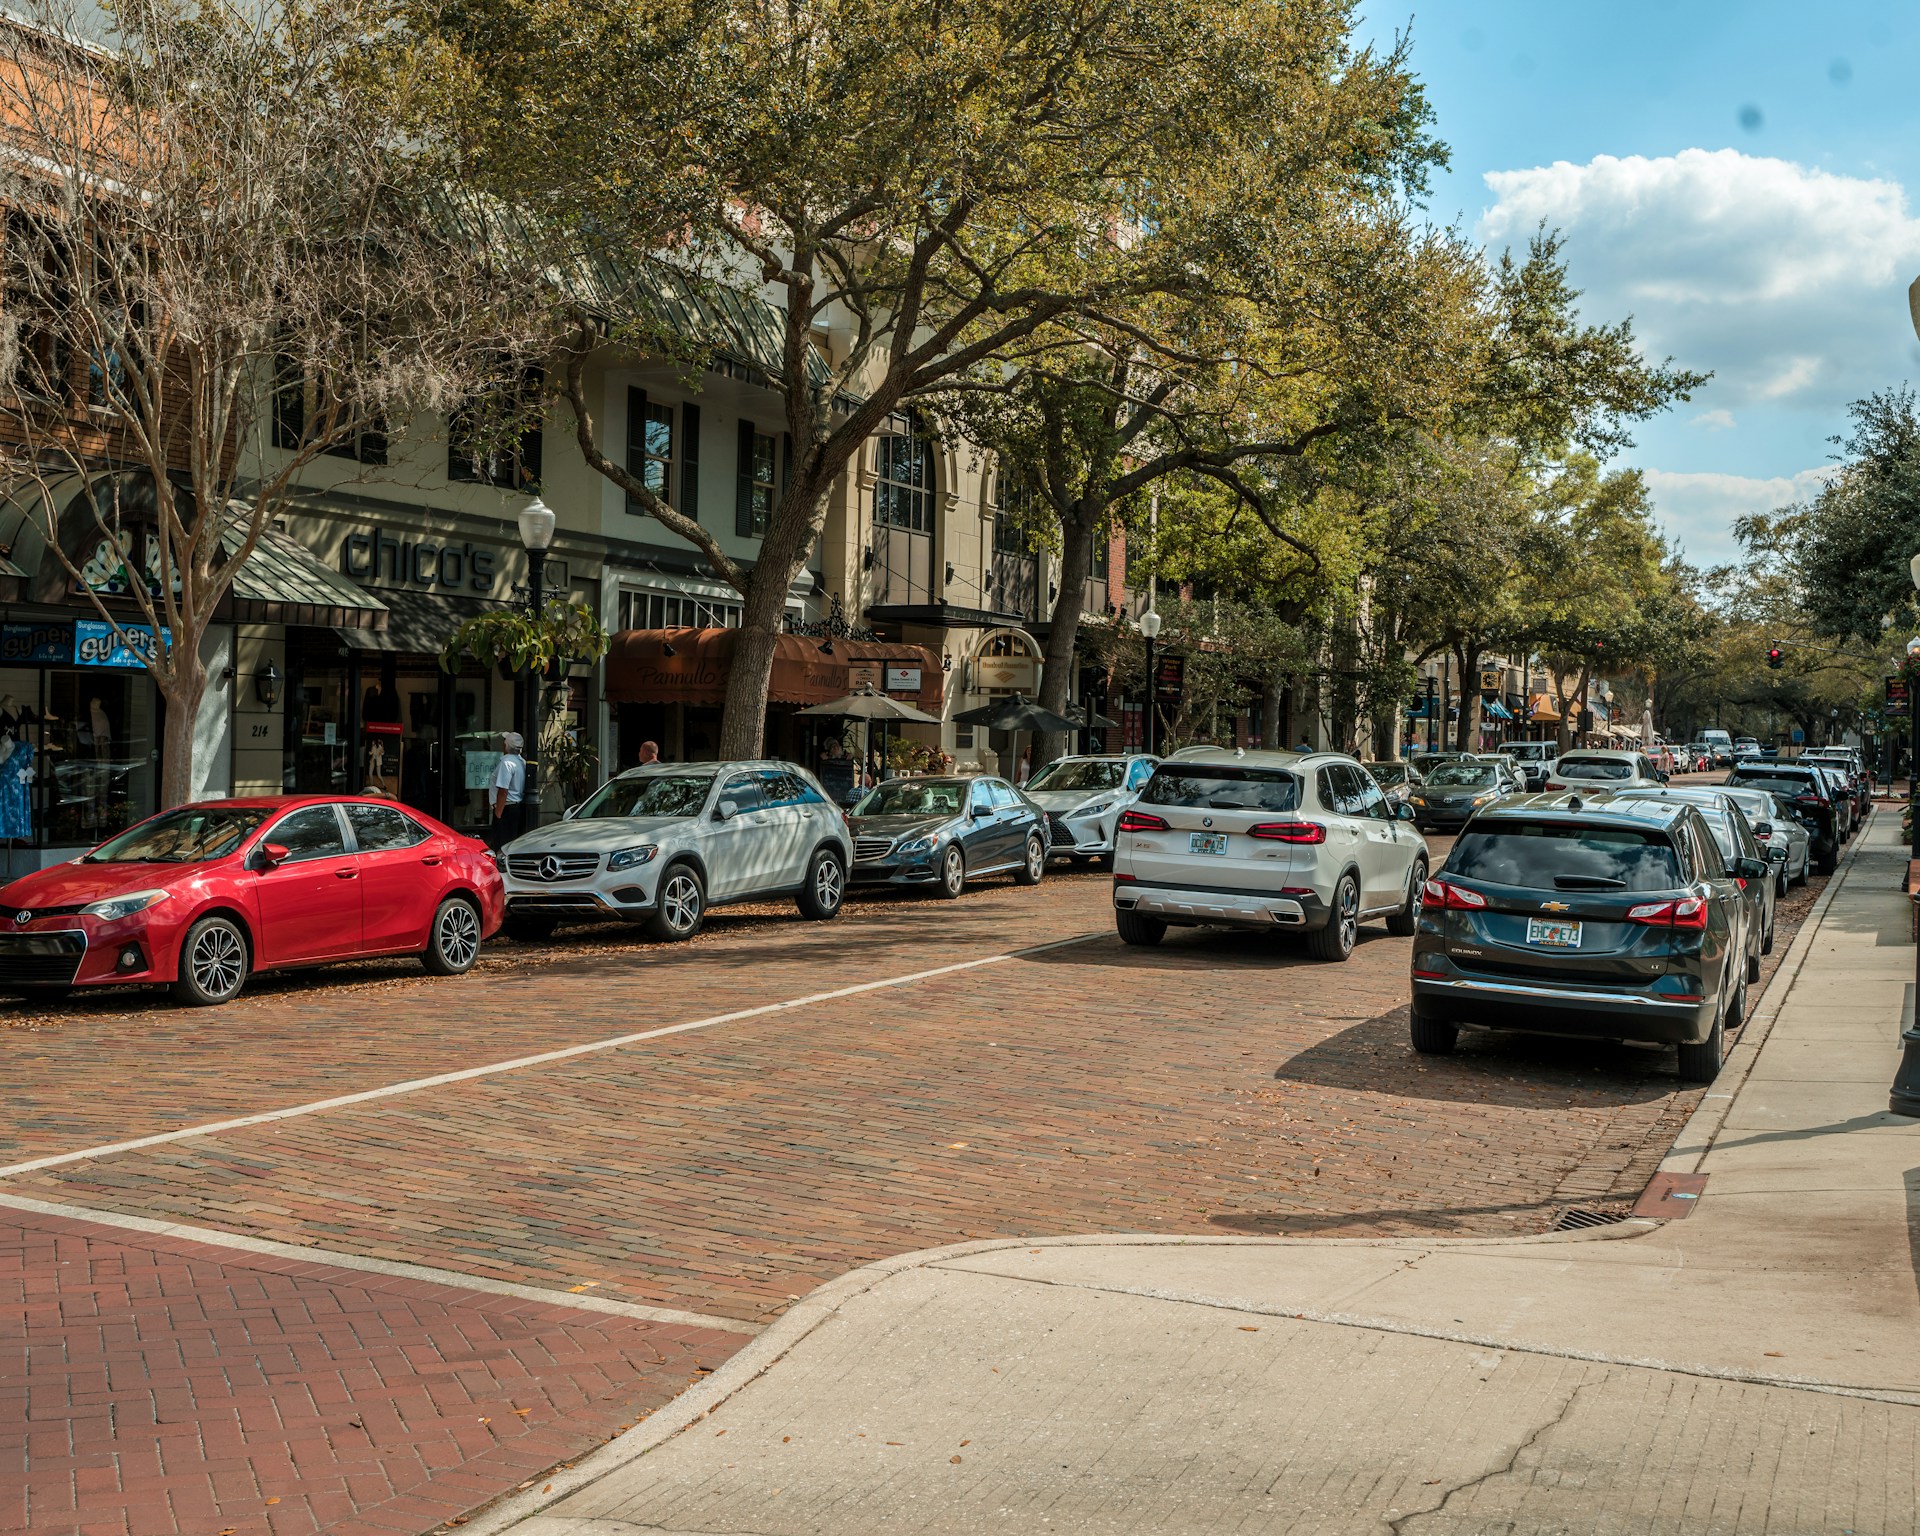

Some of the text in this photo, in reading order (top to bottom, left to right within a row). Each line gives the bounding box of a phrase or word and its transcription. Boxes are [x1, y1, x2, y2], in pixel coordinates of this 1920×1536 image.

[346, 527, 496, 590] chico's
[78, 622, 107, 632] Sunglasses
[161, 627, 172, 635] Sho
[3, 627, 72, 658] syner
[80, 627, 171, 661] synerg
[251, 724, 269, 738] 214
[1451, 947, 1483, 957] EQUINOX
